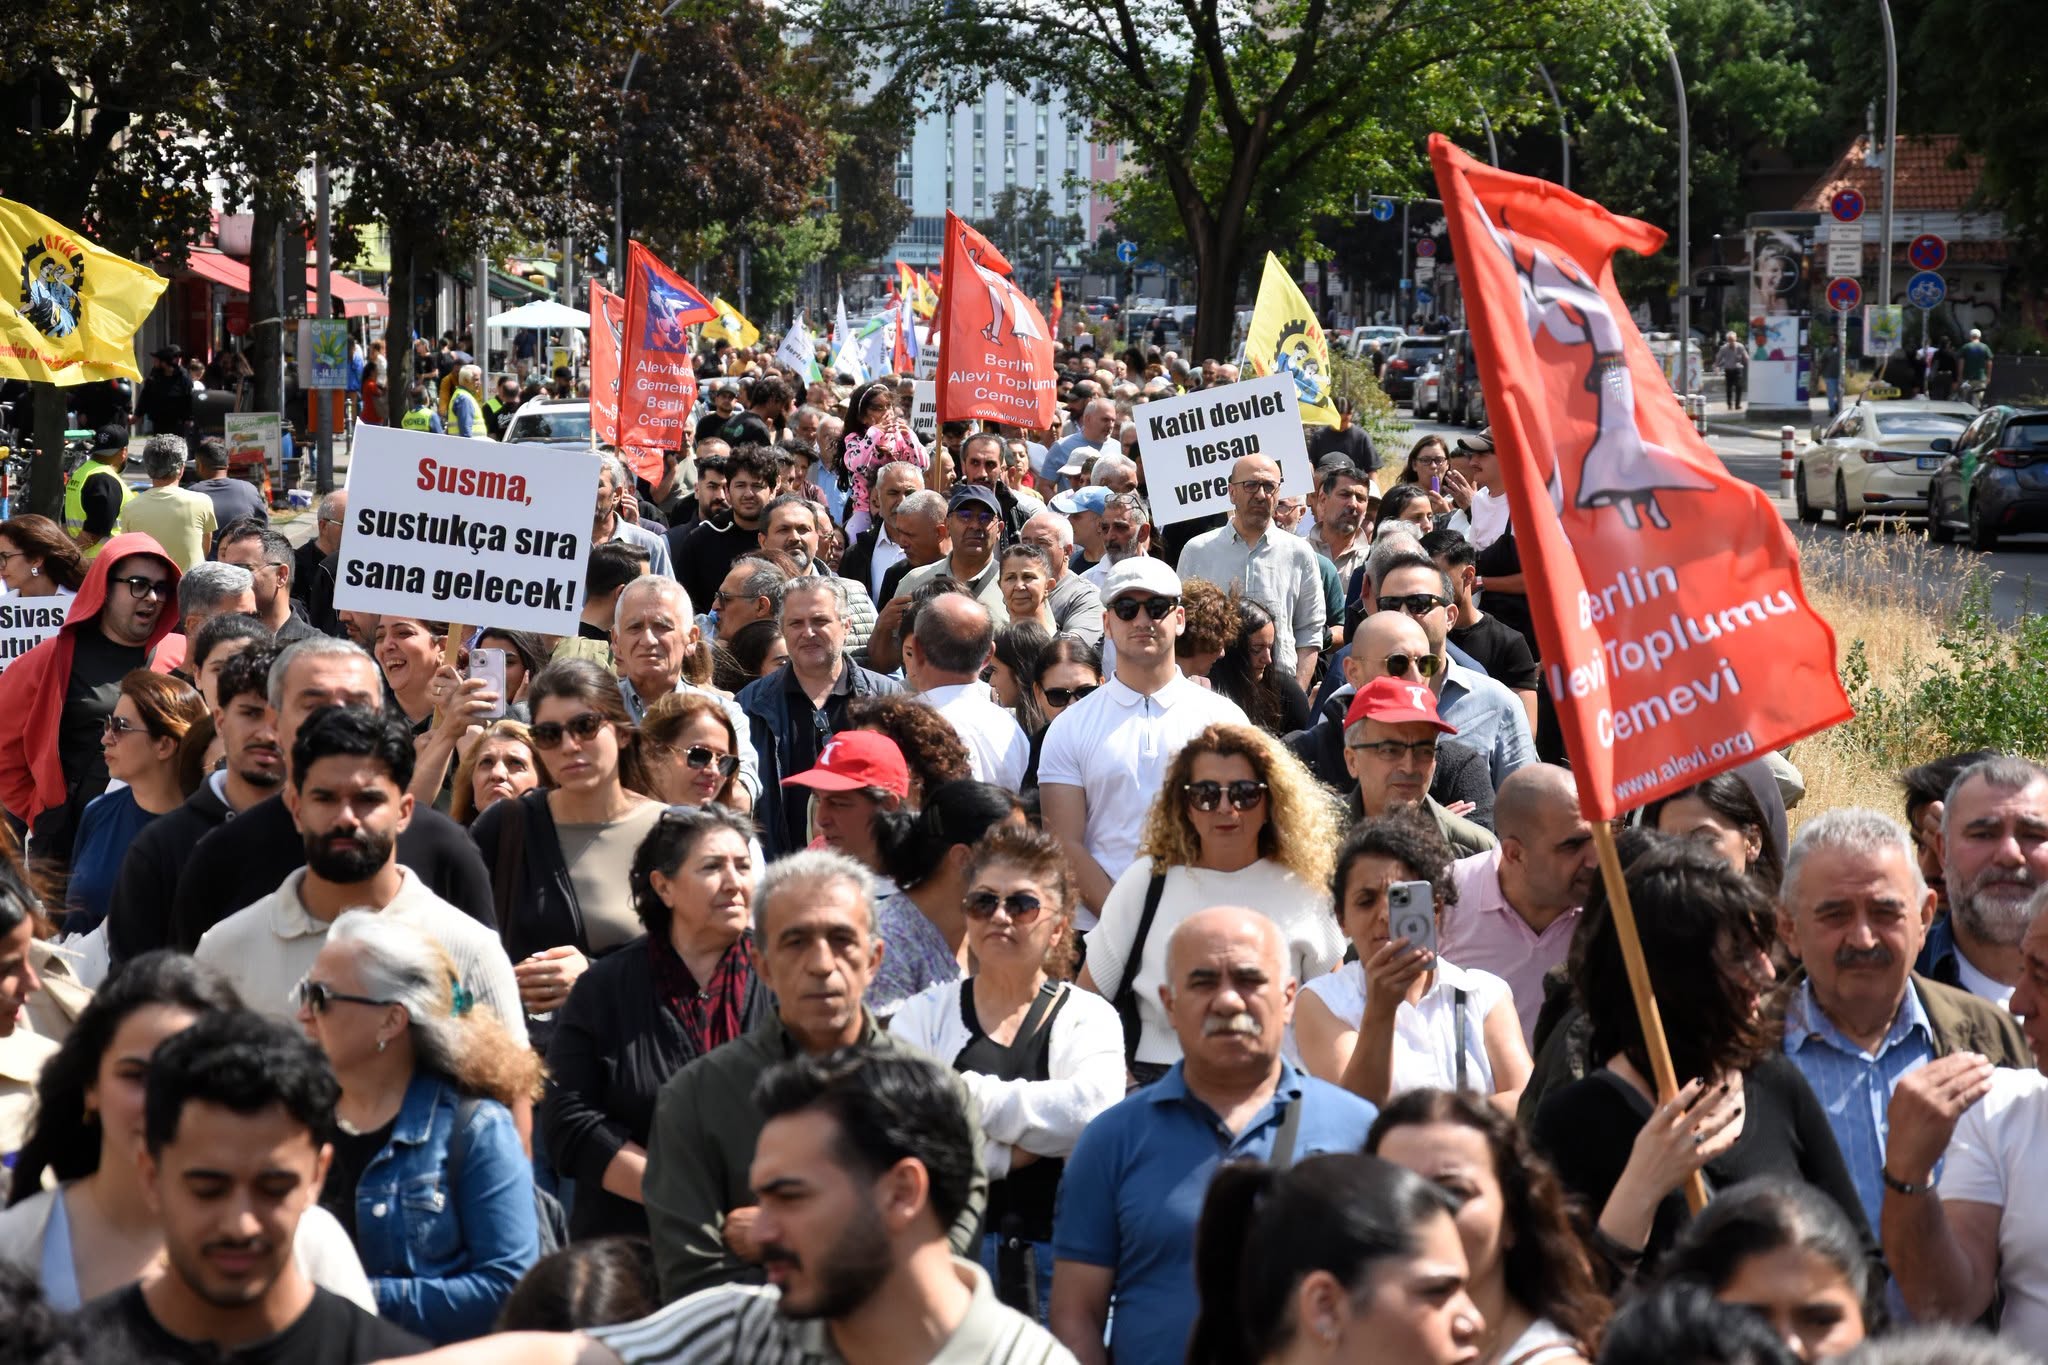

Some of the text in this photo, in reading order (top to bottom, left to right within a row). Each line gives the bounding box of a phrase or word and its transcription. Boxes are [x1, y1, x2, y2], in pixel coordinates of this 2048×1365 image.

[948, 371, 1056, 392] Alevi Toplumu
[984, 353, 1034, 372] Berlin
[975, 387, 1039, 409] Cemevi
[976, 409, 1034, 426] www.alevi.org
[1149, 391, 1285, 441] Katil devlet
[1185, 434, 1260, 468] hesap
[416, 457, 532, 506] Susma,
[357, 508, 578, 561] sustukça sıra
[345, 559, 577, 612] sana gelecek!
[1578, 563, 1679, 631] Berlin
[0, 605, 65, 629] Sivas
[1551, 589, 1798, 701] levi Toplumu
[1596, 657, 1742, 750] Cemevi
[1614, 730, 1756, 800] www.alevi.org
